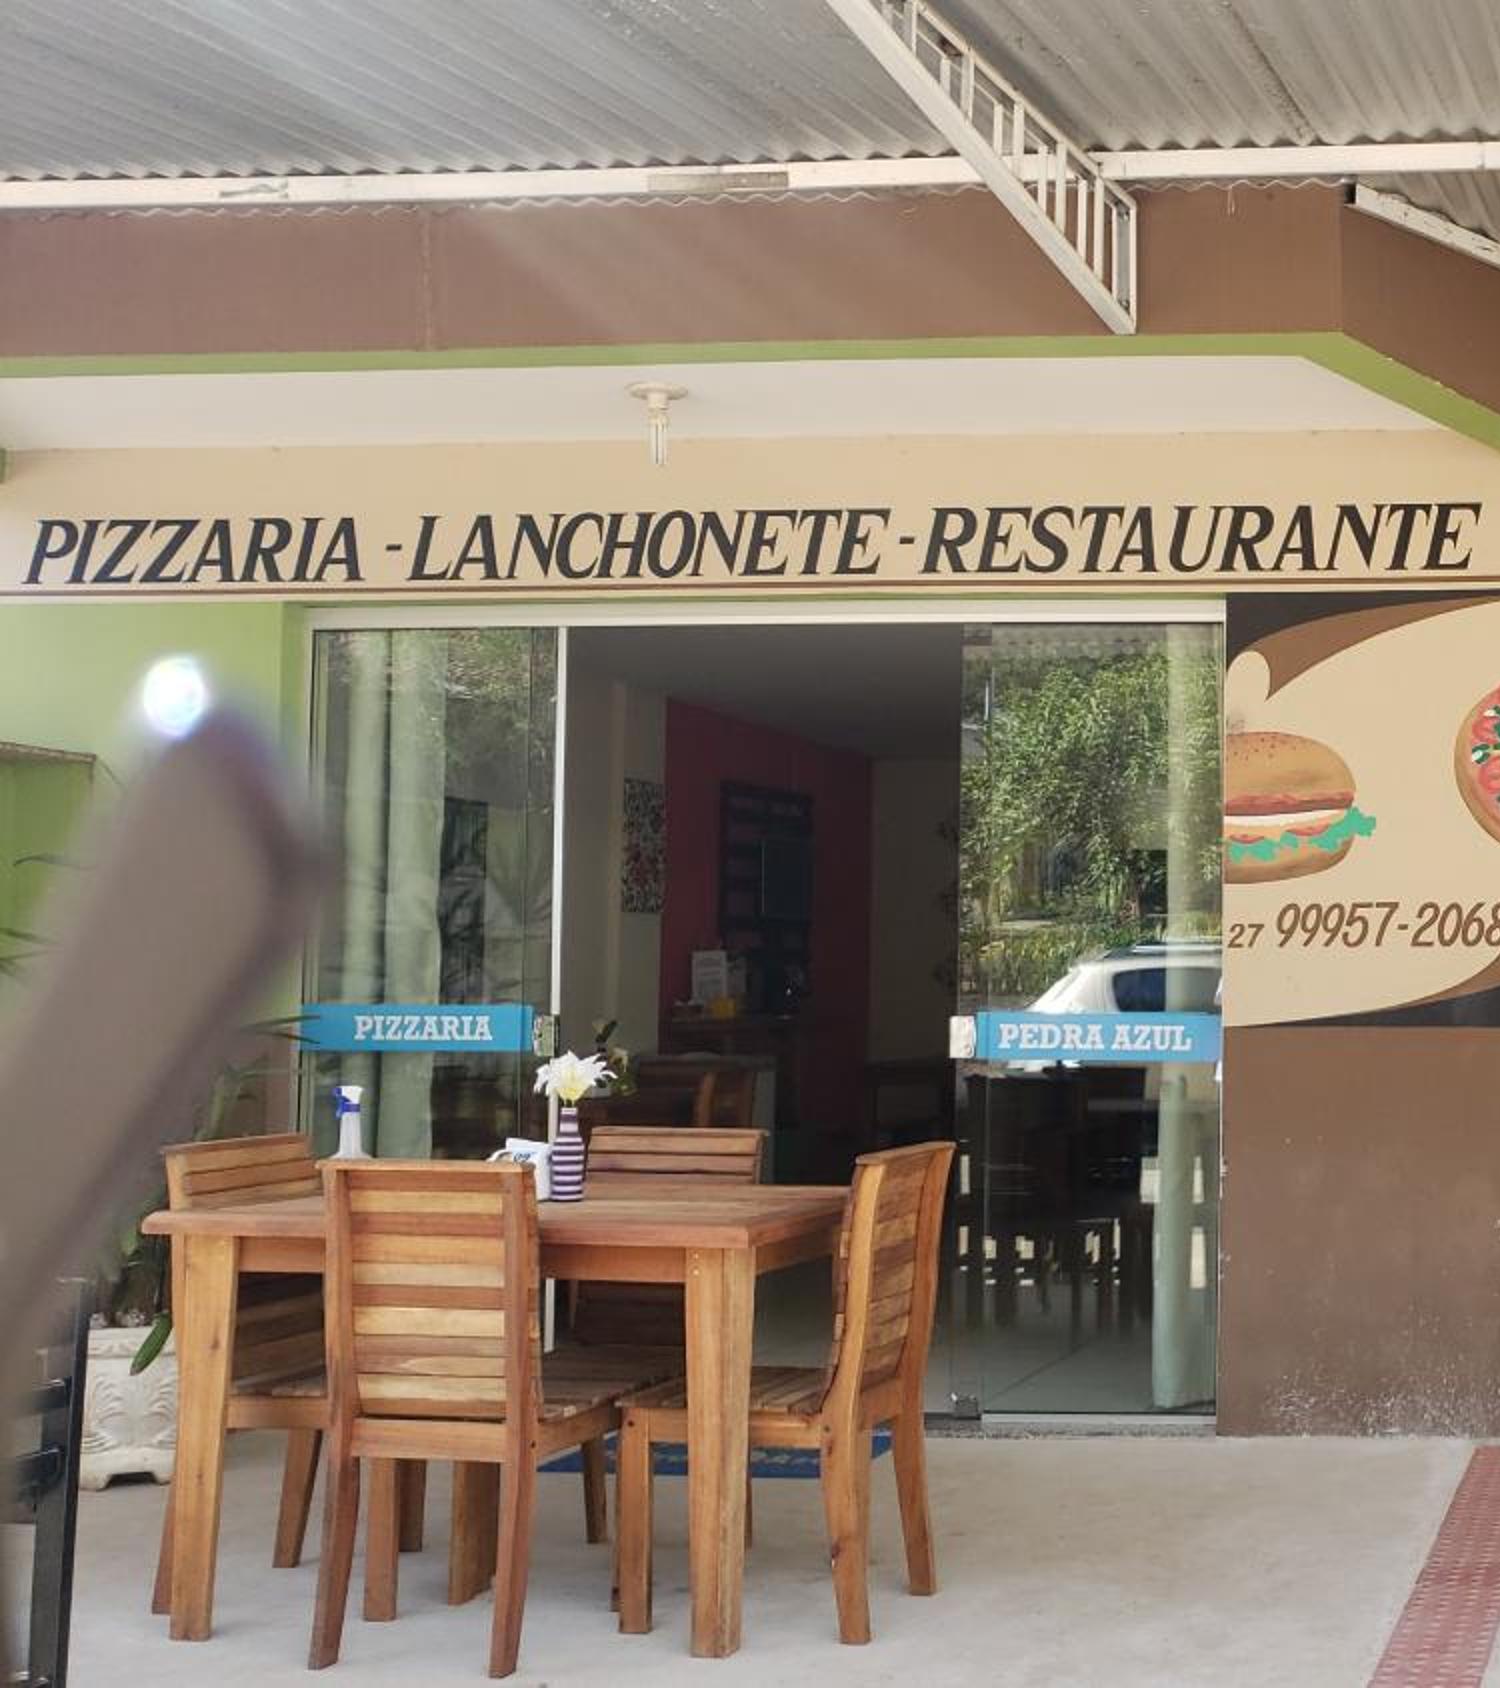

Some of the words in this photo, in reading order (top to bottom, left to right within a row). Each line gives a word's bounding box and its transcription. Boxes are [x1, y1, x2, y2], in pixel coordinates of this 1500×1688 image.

[22, 517, 364, 584] PIZZARIA
[1228, 923, 1264, 949] 27
[353, 1014, 493, 1041] PIZZARIA
[997, 1023, 1104, 1049] PEDRA
[1111, 1024, 1192, 1051] AZUL
